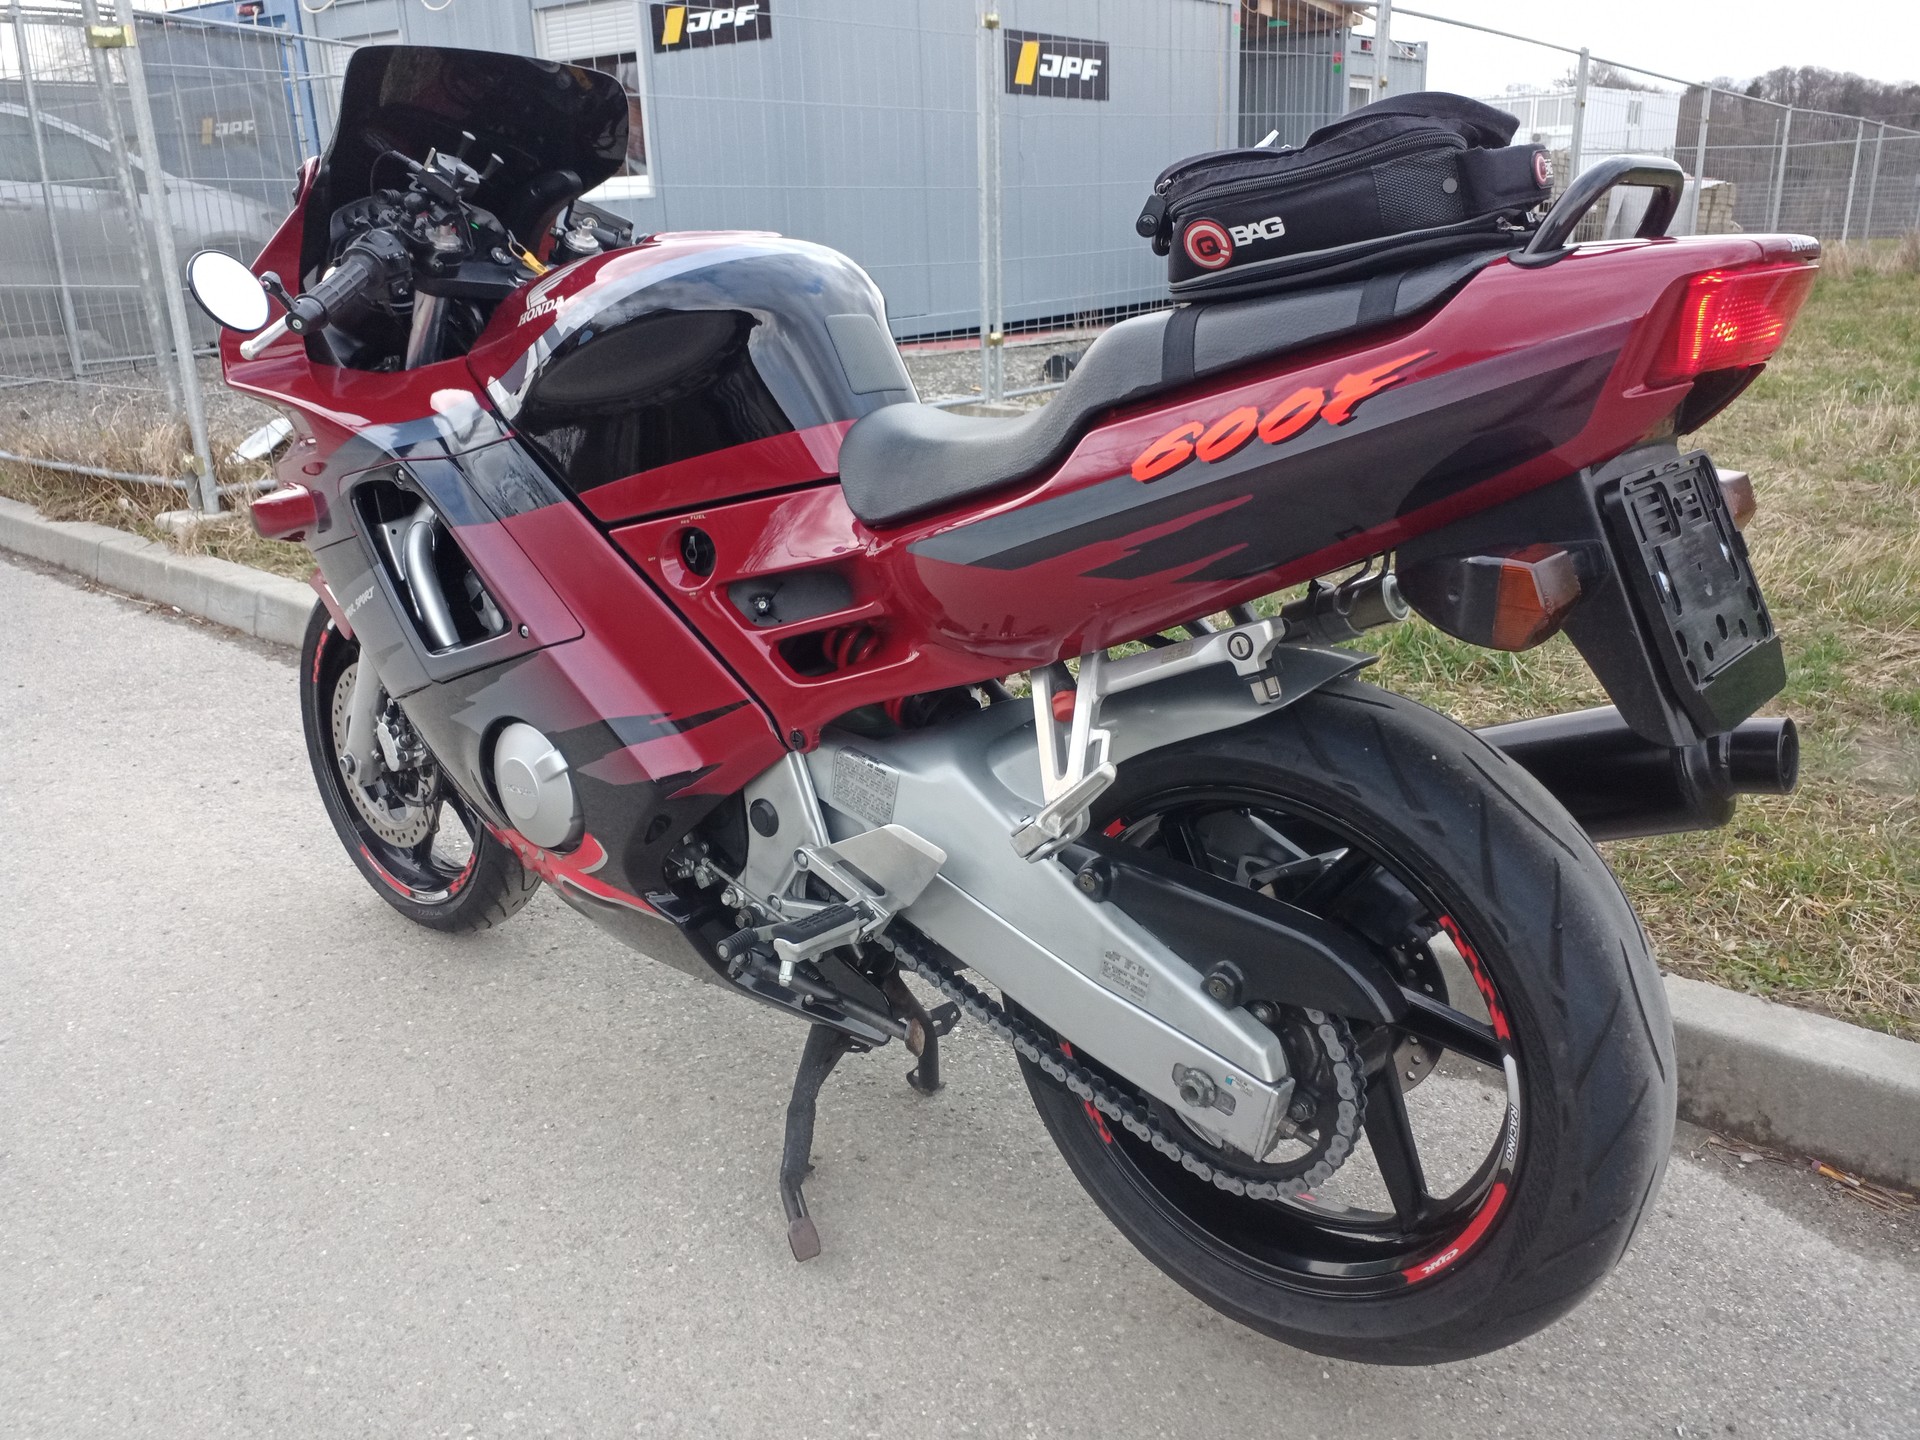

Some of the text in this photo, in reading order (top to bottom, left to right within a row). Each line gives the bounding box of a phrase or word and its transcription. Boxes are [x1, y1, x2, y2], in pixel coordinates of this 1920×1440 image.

[686, 4, 760, 33] JPF
[1039, 53, 1102, 81] JPF
[215, 119, 255, 137] JPF
[1228, 216, 1286, 247] BAG
[517, 295, 565, 327] HONDA
[1131, 349, 1432, 483] 600F
[1505, 1102, 1520, 1162] RACING
